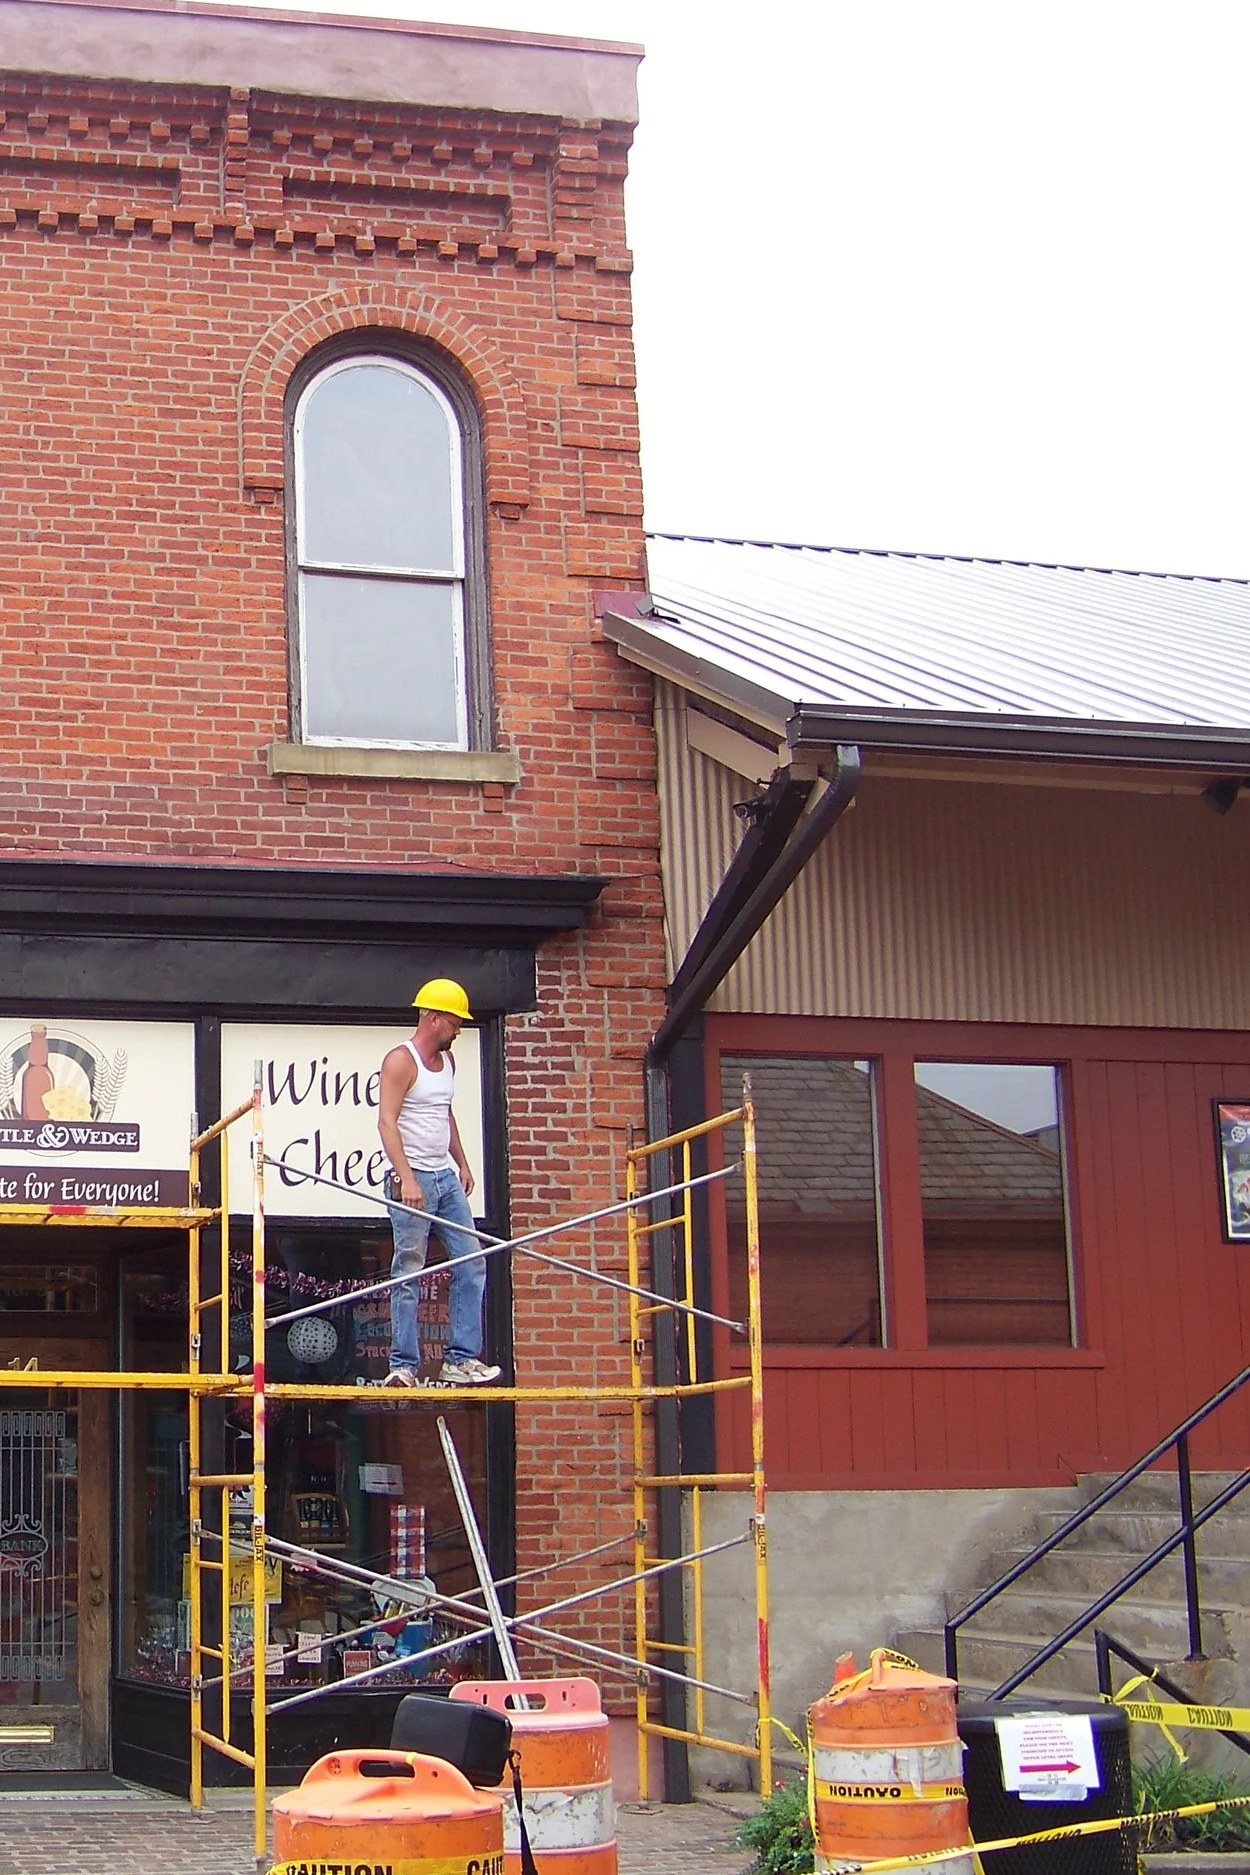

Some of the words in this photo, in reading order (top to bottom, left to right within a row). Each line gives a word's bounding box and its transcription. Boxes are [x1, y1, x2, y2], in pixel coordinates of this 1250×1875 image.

[267, 1056, 380, 1107] Wine
[37, 1123, 69, 1149] &
[69, 1127, 138, 1146] WEDGE
[279, 1128, 385, 1187] Chee
[23, 1172, 55, 1200] for
[60, 1178, 160, 1208] Everyone!
[8, 1357, 39, 1371] 14
[0, 1540, 43, 1551] BANK
[254, 1525, 264, 1564] BIL-JAX
[829, 1785, 901, 1798] CAUTION
